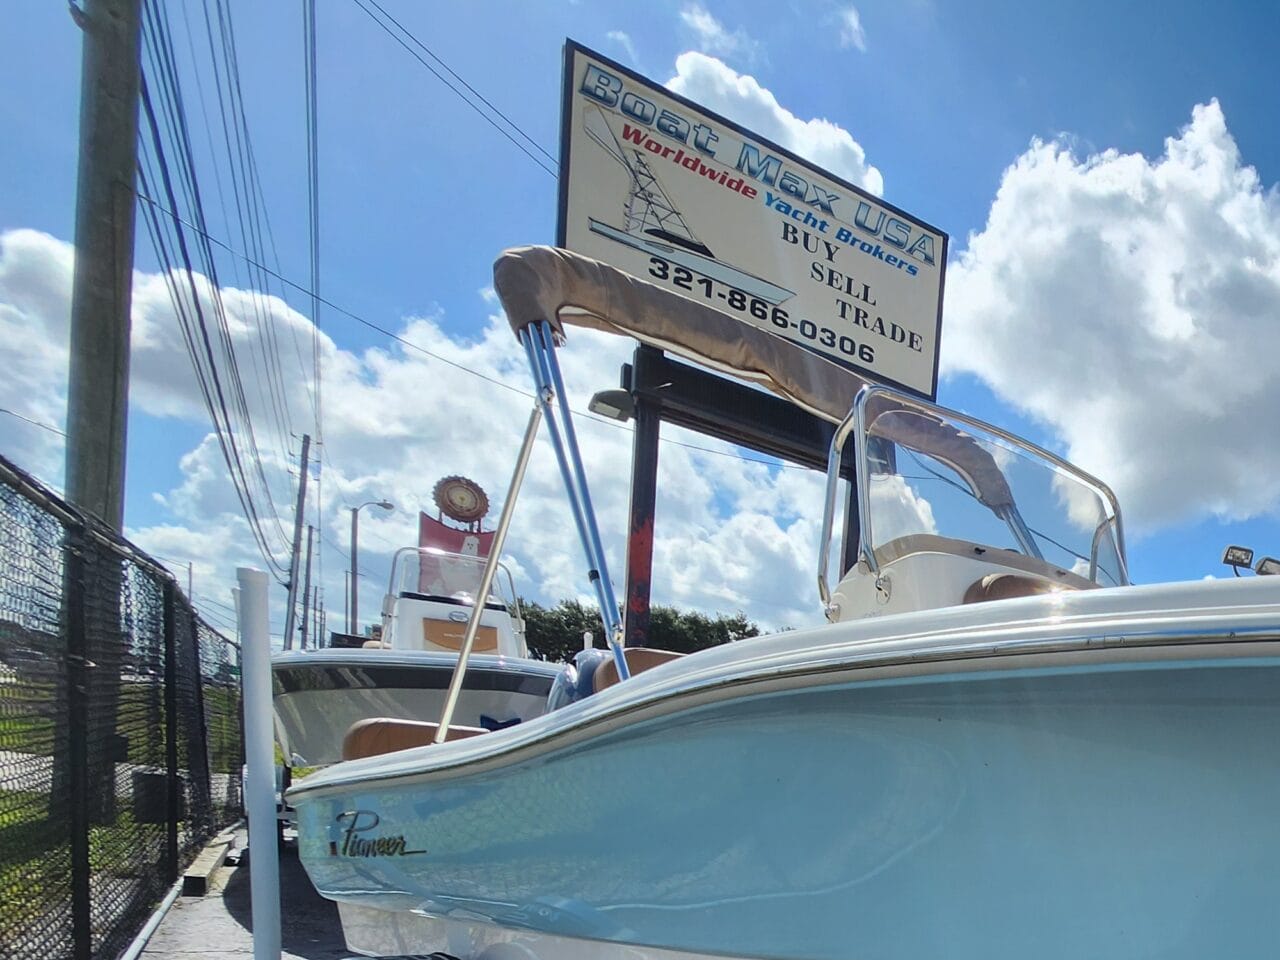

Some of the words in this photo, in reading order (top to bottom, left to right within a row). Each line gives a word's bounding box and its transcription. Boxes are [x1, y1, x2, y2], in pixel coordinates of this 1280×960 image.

[578, 63, 719, 158] Boat
[736, 142, 840, 218] Max
[854, 200, 936, 267] USA
[621, 123, 758, 200] Worldwide
[764, 191, 830, 233] Yacht
[835, 226, 920, 277] Brokers
[781, 221, 841, 263] BUY
[648, 257, 875, 364] 321-866-0306
[810, 261, 877, 306] SELL
[835, 298, 923, 353] TRADE
[336, 809, 427, 858] Pioneer
